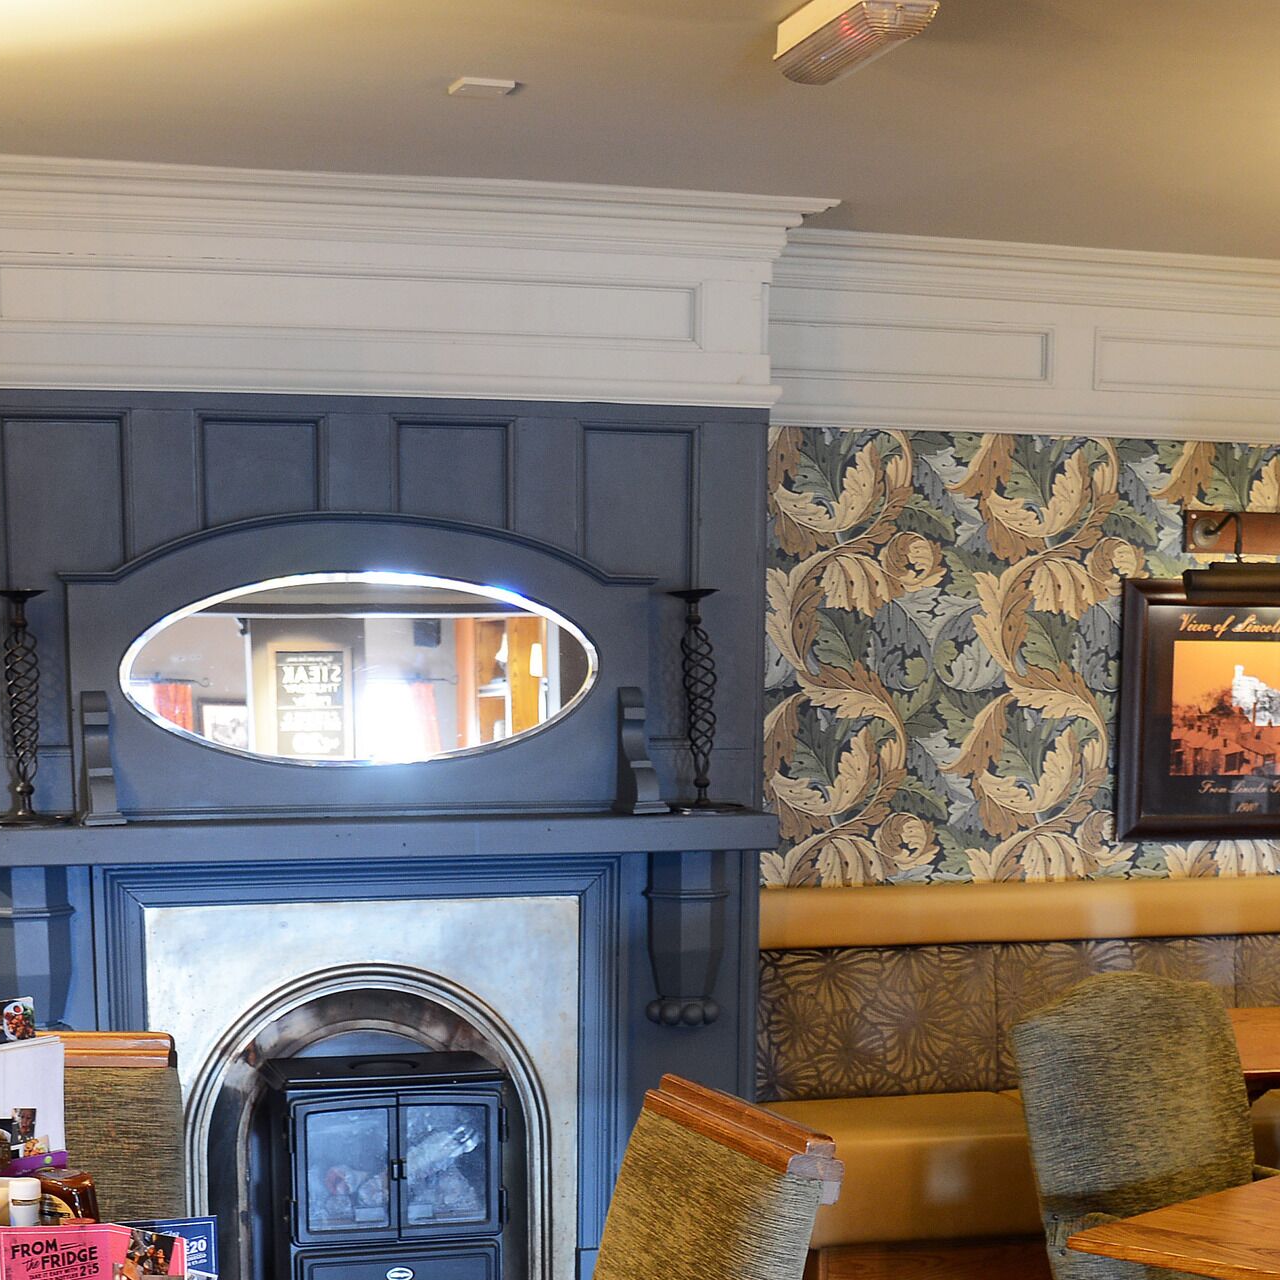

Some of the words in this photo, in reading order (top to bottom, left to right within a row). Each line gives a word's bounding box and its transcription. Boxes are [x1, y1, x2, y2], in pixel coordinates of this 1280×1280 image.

[1179, 613, 1211, 632] View
[1212, 615, 1235, 638] of
[1198, 780, 1227, 794] From
[1228, 780, 1268, 794] Lincoln
[11, 1238, 58, 1260] FROM
[41, 1246, 98, 1270] FRIDGE
[80, 1266, 87, 1277] 2
